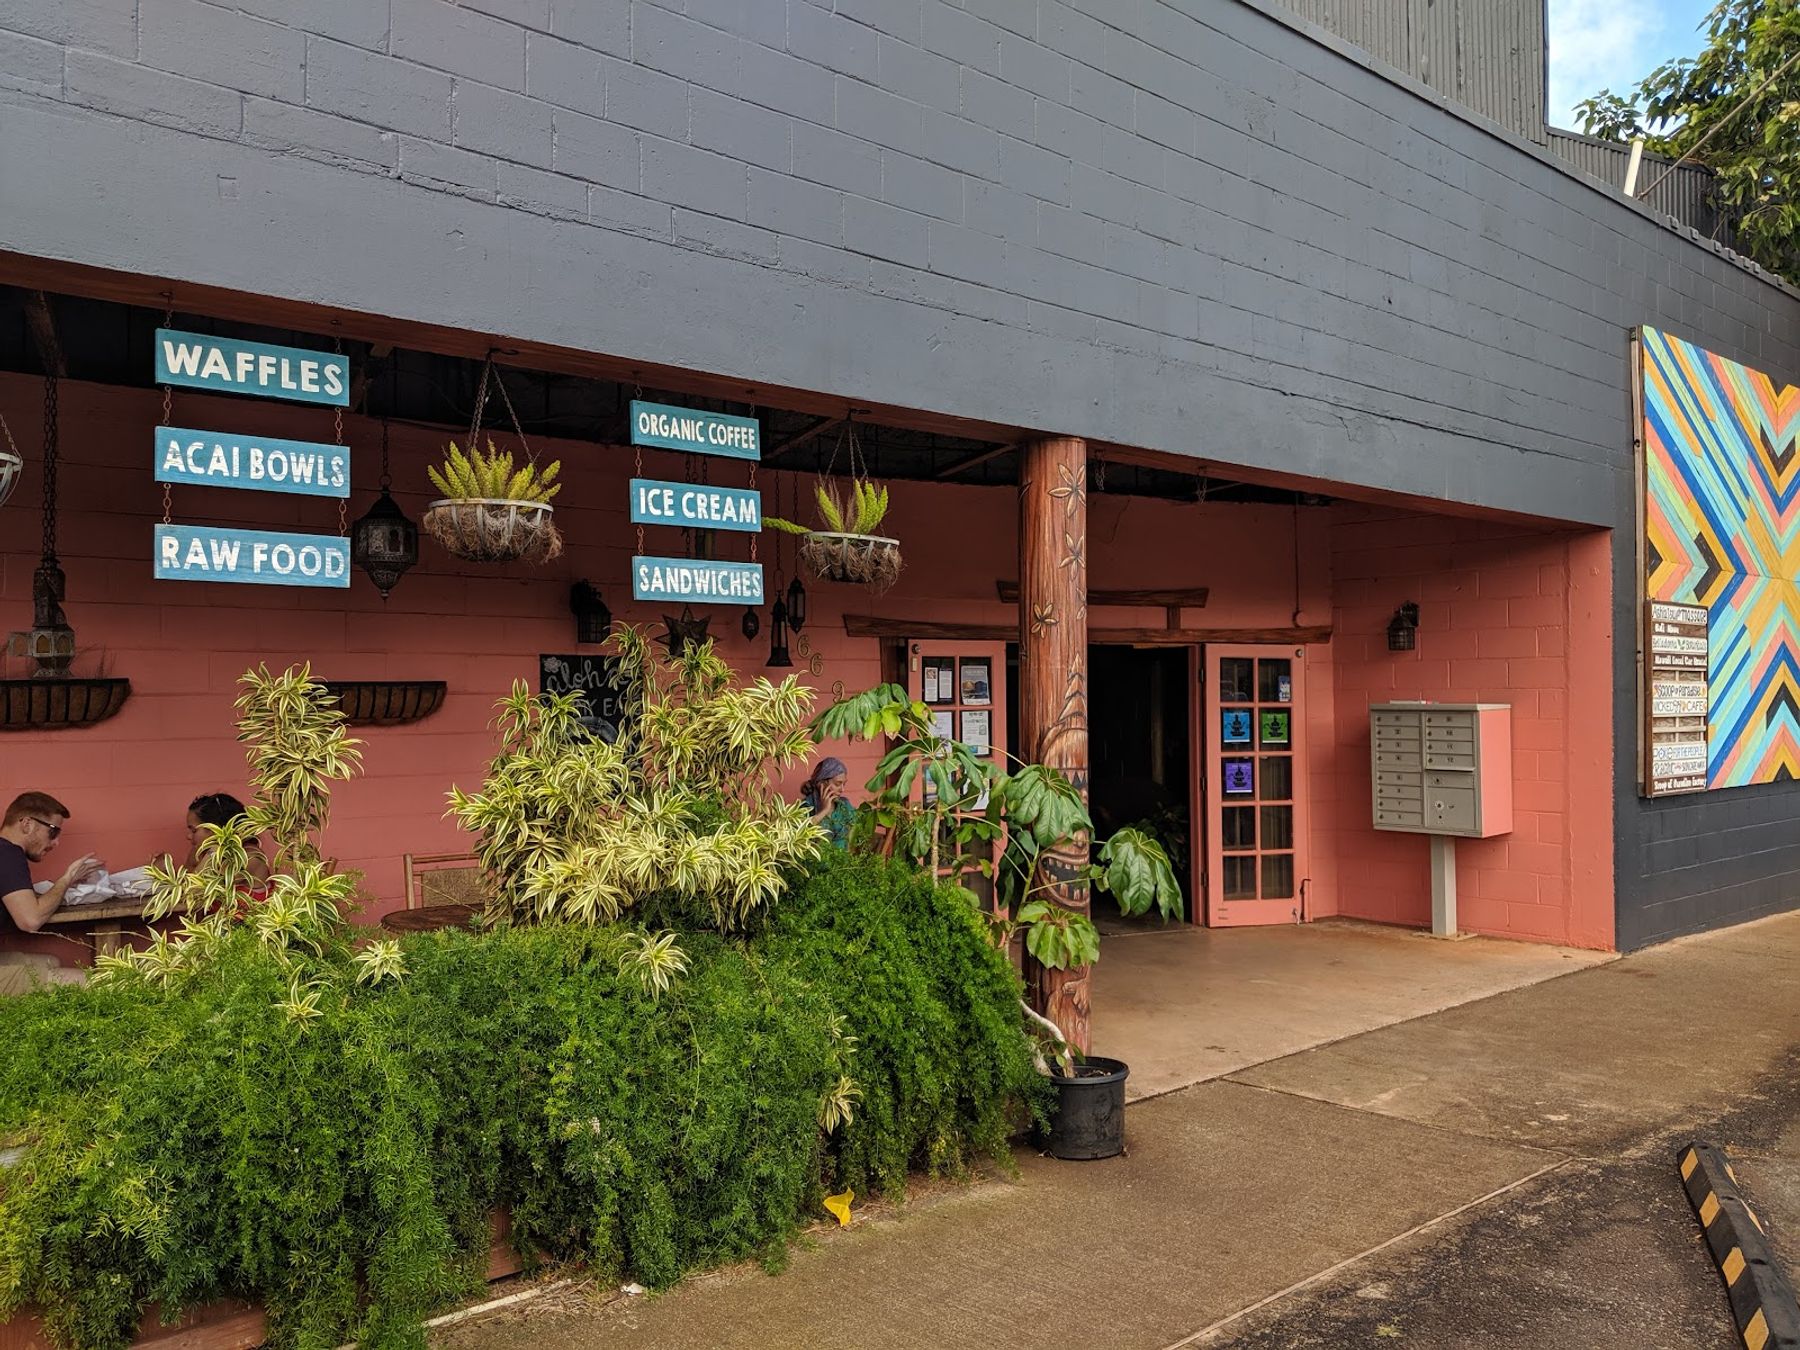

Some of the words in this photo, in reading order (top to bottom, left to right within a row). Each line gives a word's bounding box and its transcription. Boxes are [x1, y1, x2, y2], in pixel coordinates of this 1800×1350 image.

[163, 341, 342, 395] WAFFLES
[639, 412, 705, 443] ORGANIC
[708, 423, 756, 449] COFFEE
[163, 440, 239, 477] ACAI
[250, 448, 344, 487] BOWLS
[640, 488, 675, 516] ICE
[682, 492, 757, 524] CREAM
[161, 536, 240, 571] RAW
[253, 543, 344, 578] FOOD
[640, 564, 761, 597] SANDWICHES
[1687, 700, 1703, 711] CAFE
